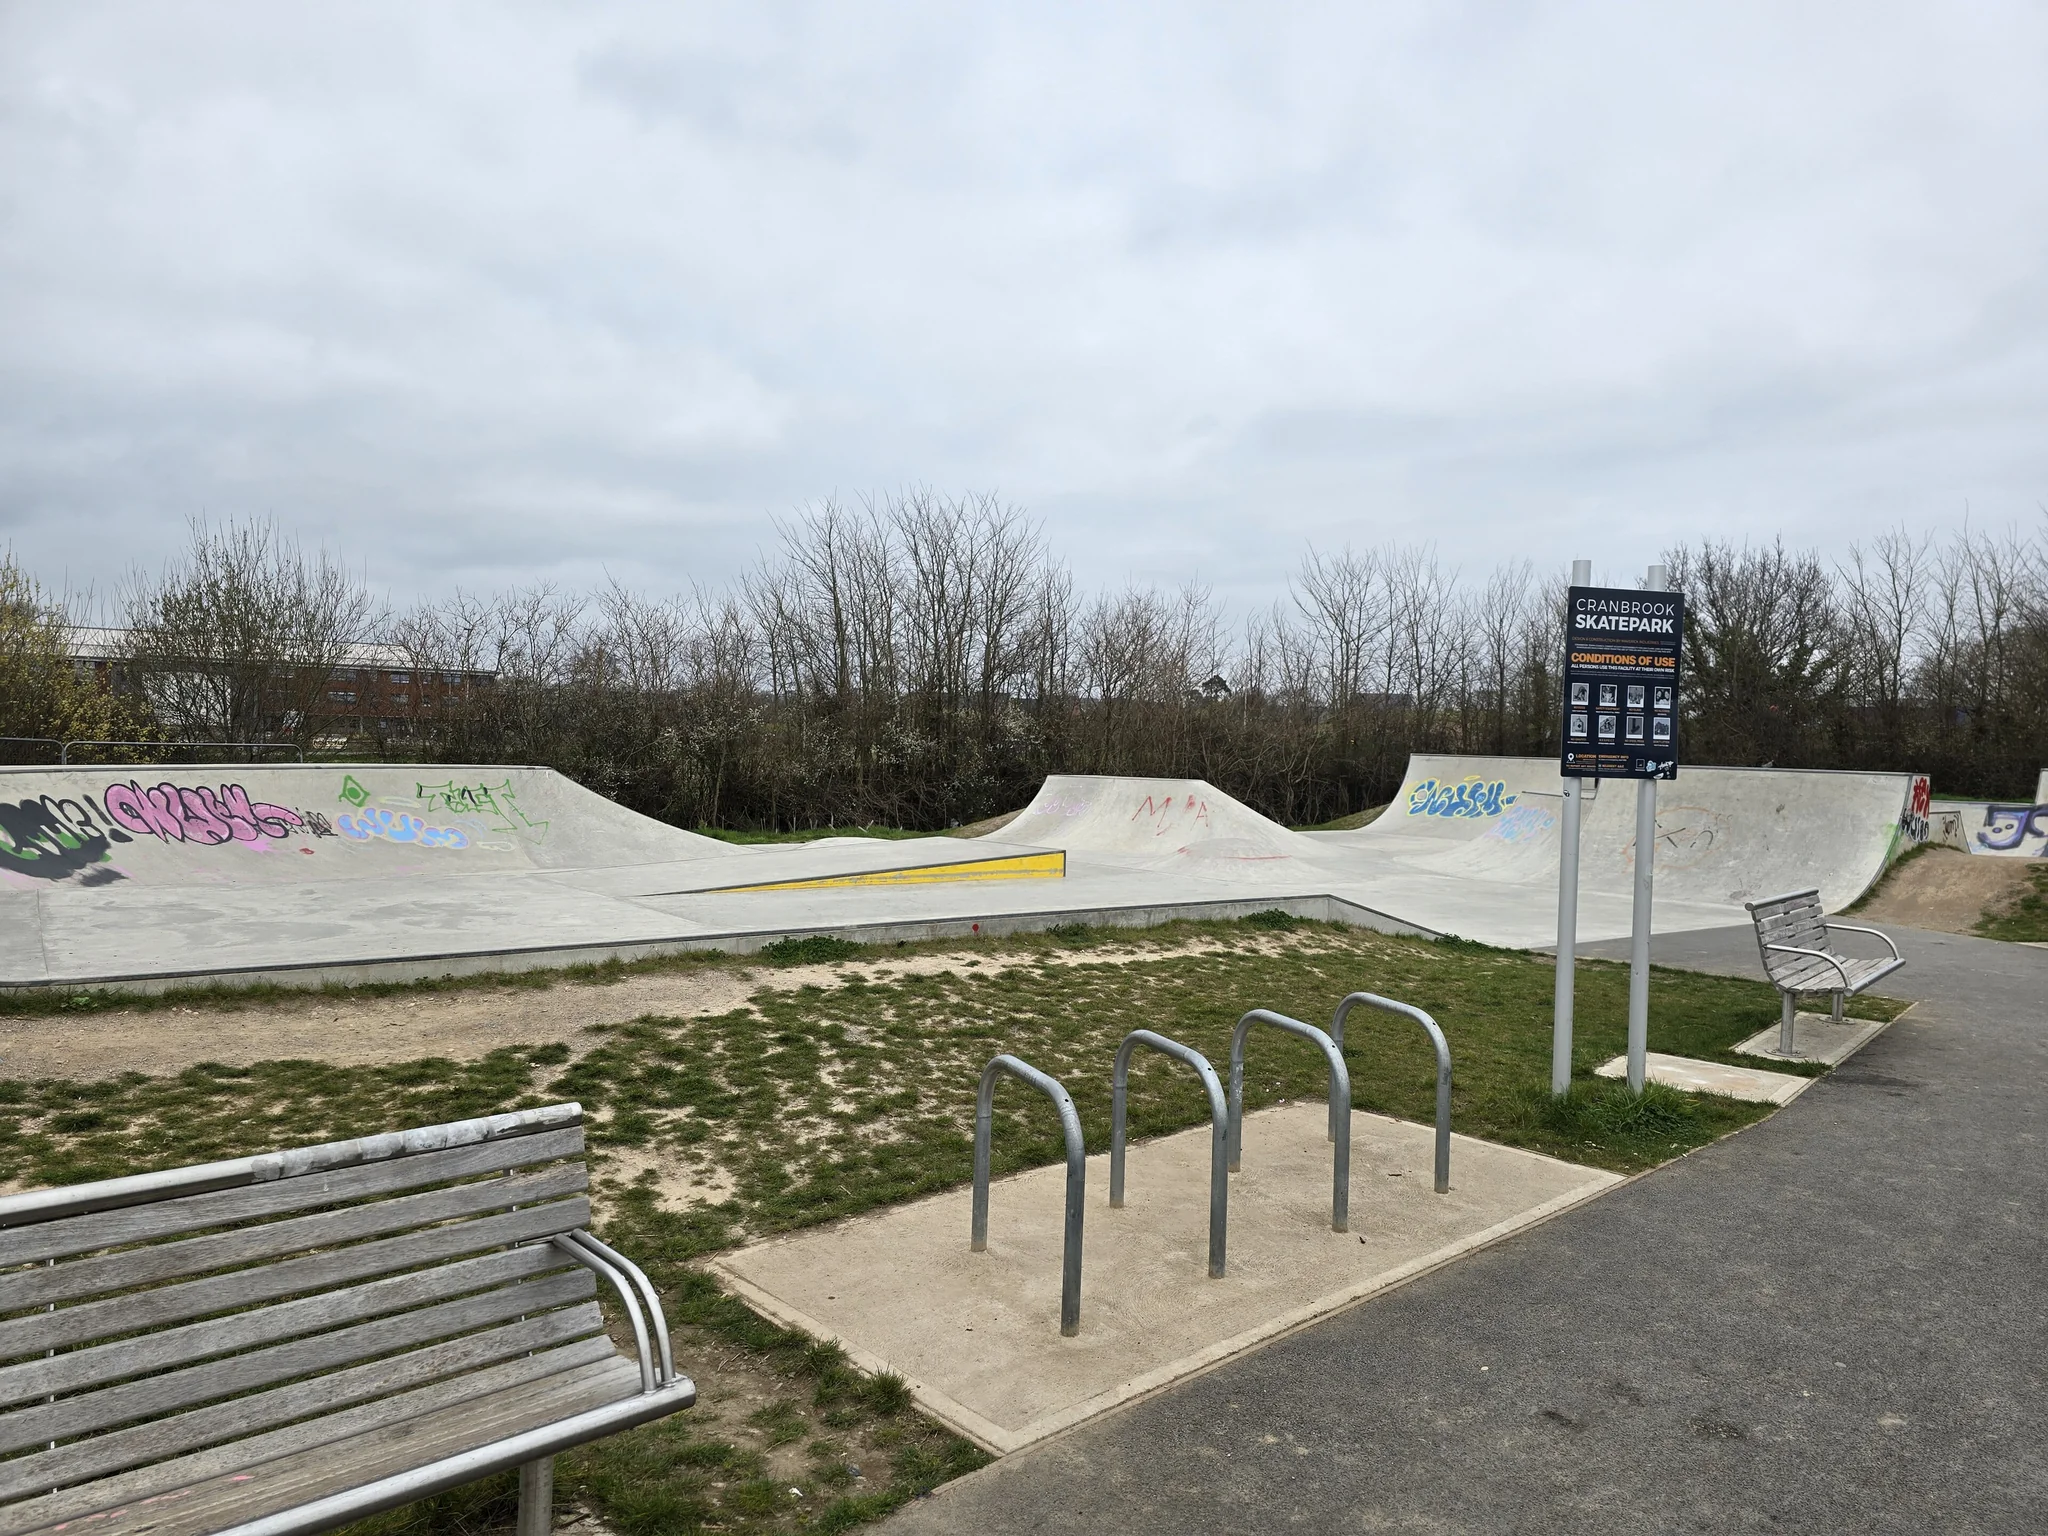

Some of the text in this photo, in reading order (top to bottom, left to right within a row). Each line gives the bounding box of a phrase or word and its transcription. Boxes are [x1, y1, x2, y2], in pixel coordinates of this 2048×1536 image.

[1576, 598, 1675, 616] CRANBROOK
[1575, 614, 1674, 634] SKATEPARK
[1571, 652, 1676, 667] CONDITIONS OF USE
